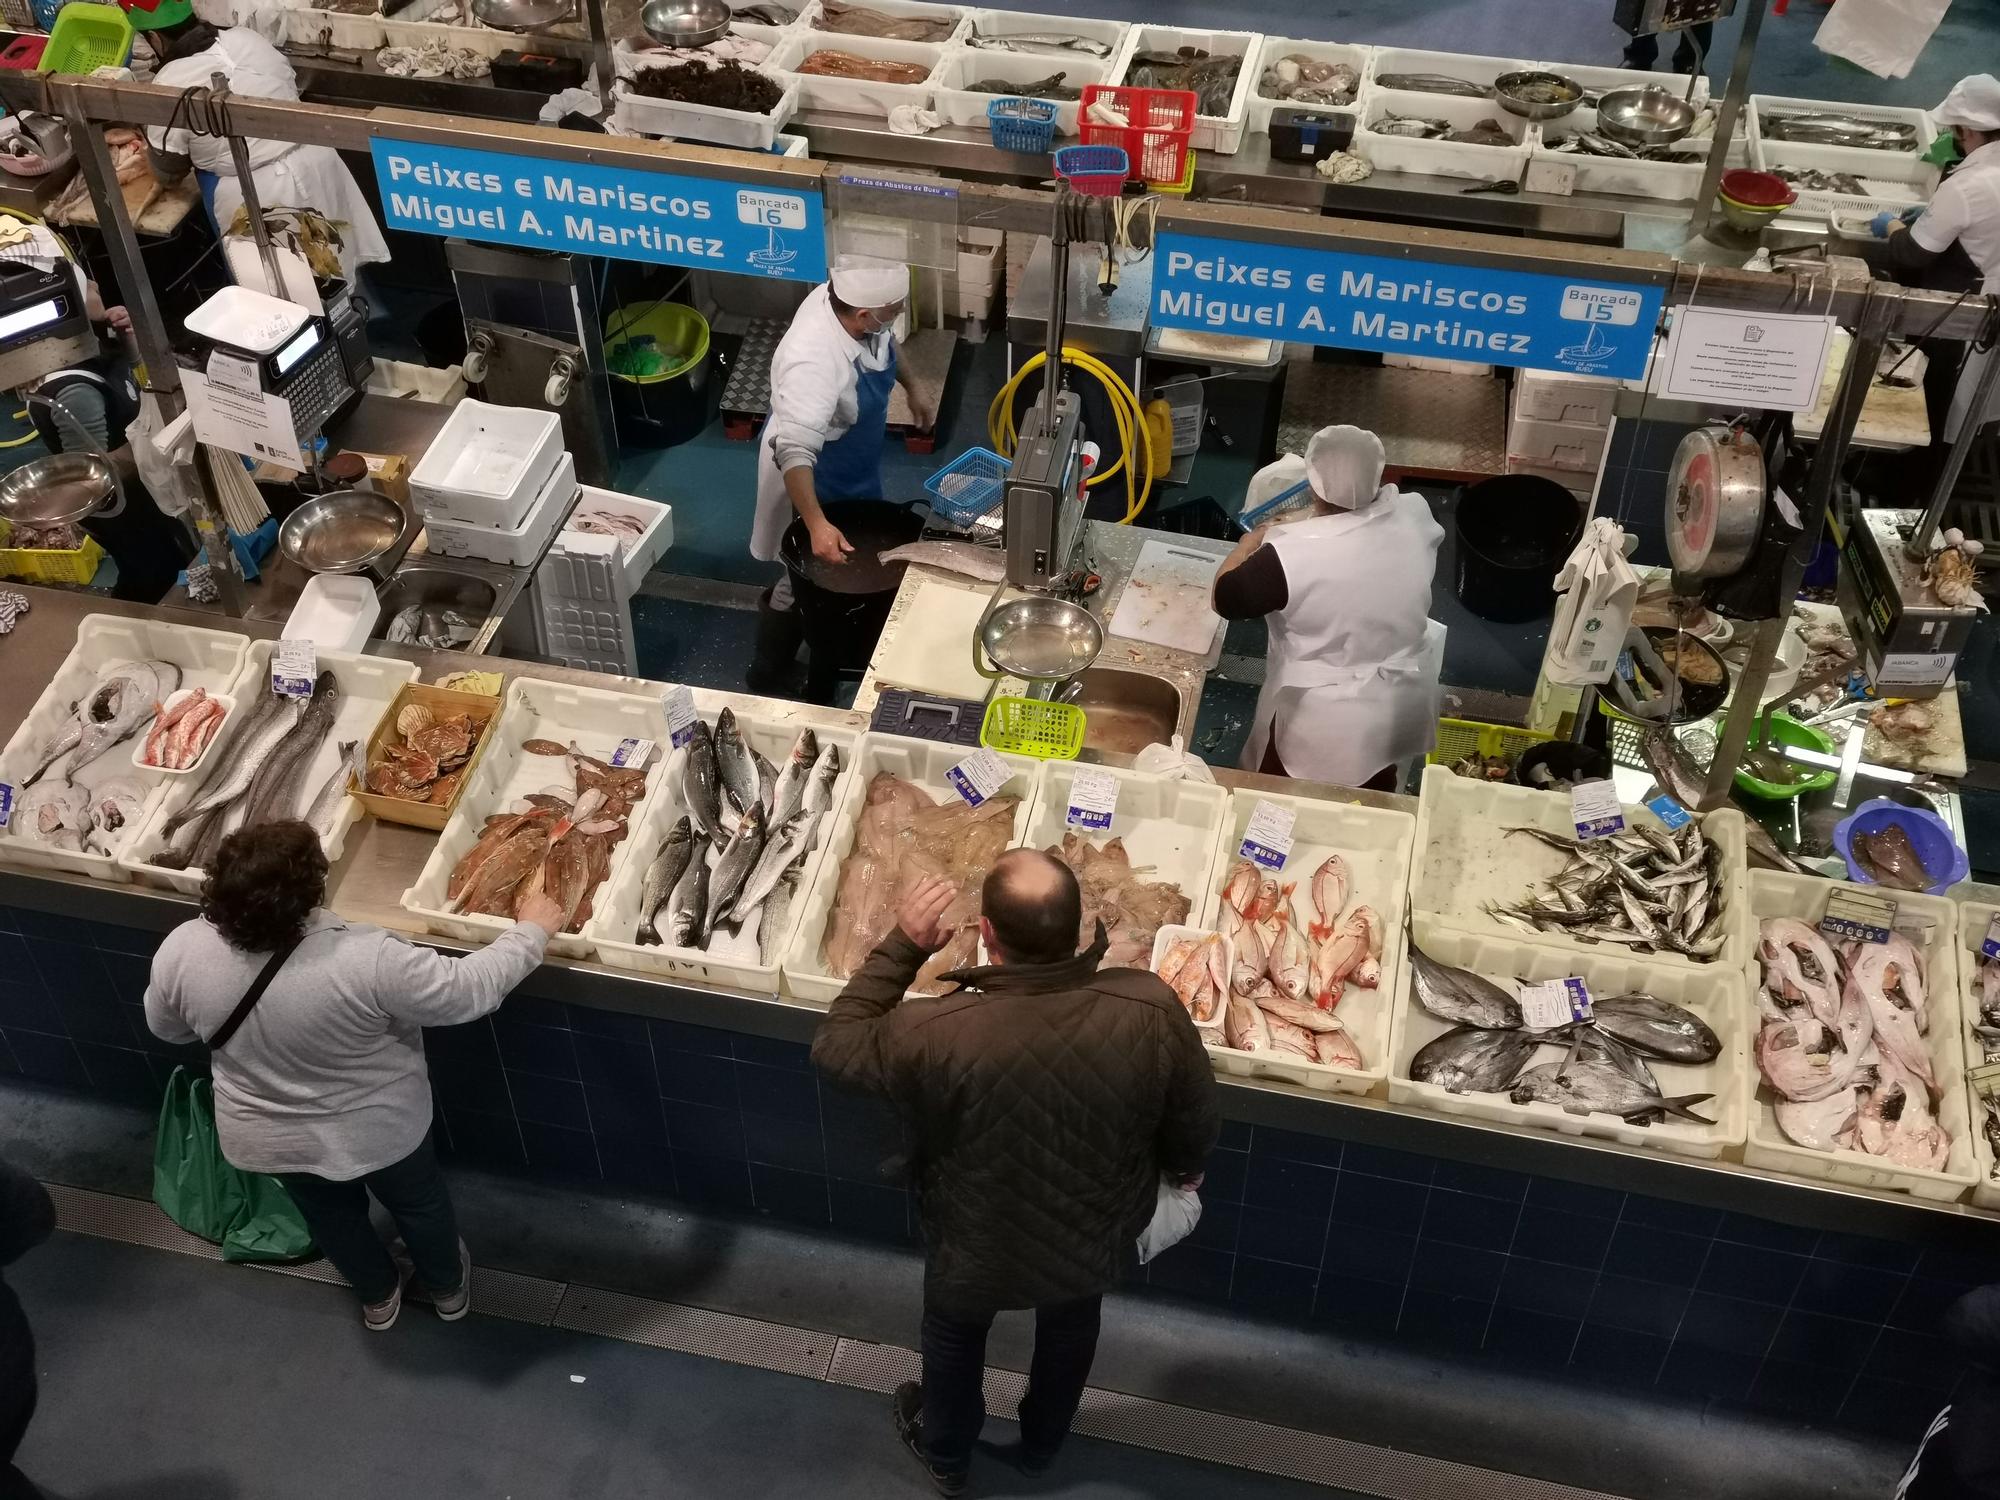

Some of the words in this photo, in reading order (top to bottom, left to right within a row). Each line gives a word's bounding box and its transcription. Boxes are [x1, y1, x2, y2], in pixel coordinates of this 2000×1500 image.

[387, 155, 502, 193] Peixes
[514, 178, 533, 198] e
[543, 175, 711, 220] Mariscos
[853, 177, 873, 186] Praza
[884, 181, 912, 190] Abastos
[738, 194, 799, 211] Bancada
[390, 193, 506, 230] Miguel
[518, 209, 553, 237] A.
[564, 215, 725, 258] Martinez
[757, 207, 782, 225] 16
[1168, 251, 1292, 289] Peixes
[1306, 273, 1326, 293] e
[1340, 270, 1528, 315] Mariscos
[1569, 289, 1637, 306] Bancada
[1585, 302, 1614, 321] 15
[1159, 289, 1285, 327] Miguel
[1298, 305, 1336, 333] A.
[1352, 310, 1531, 354] Martinez
